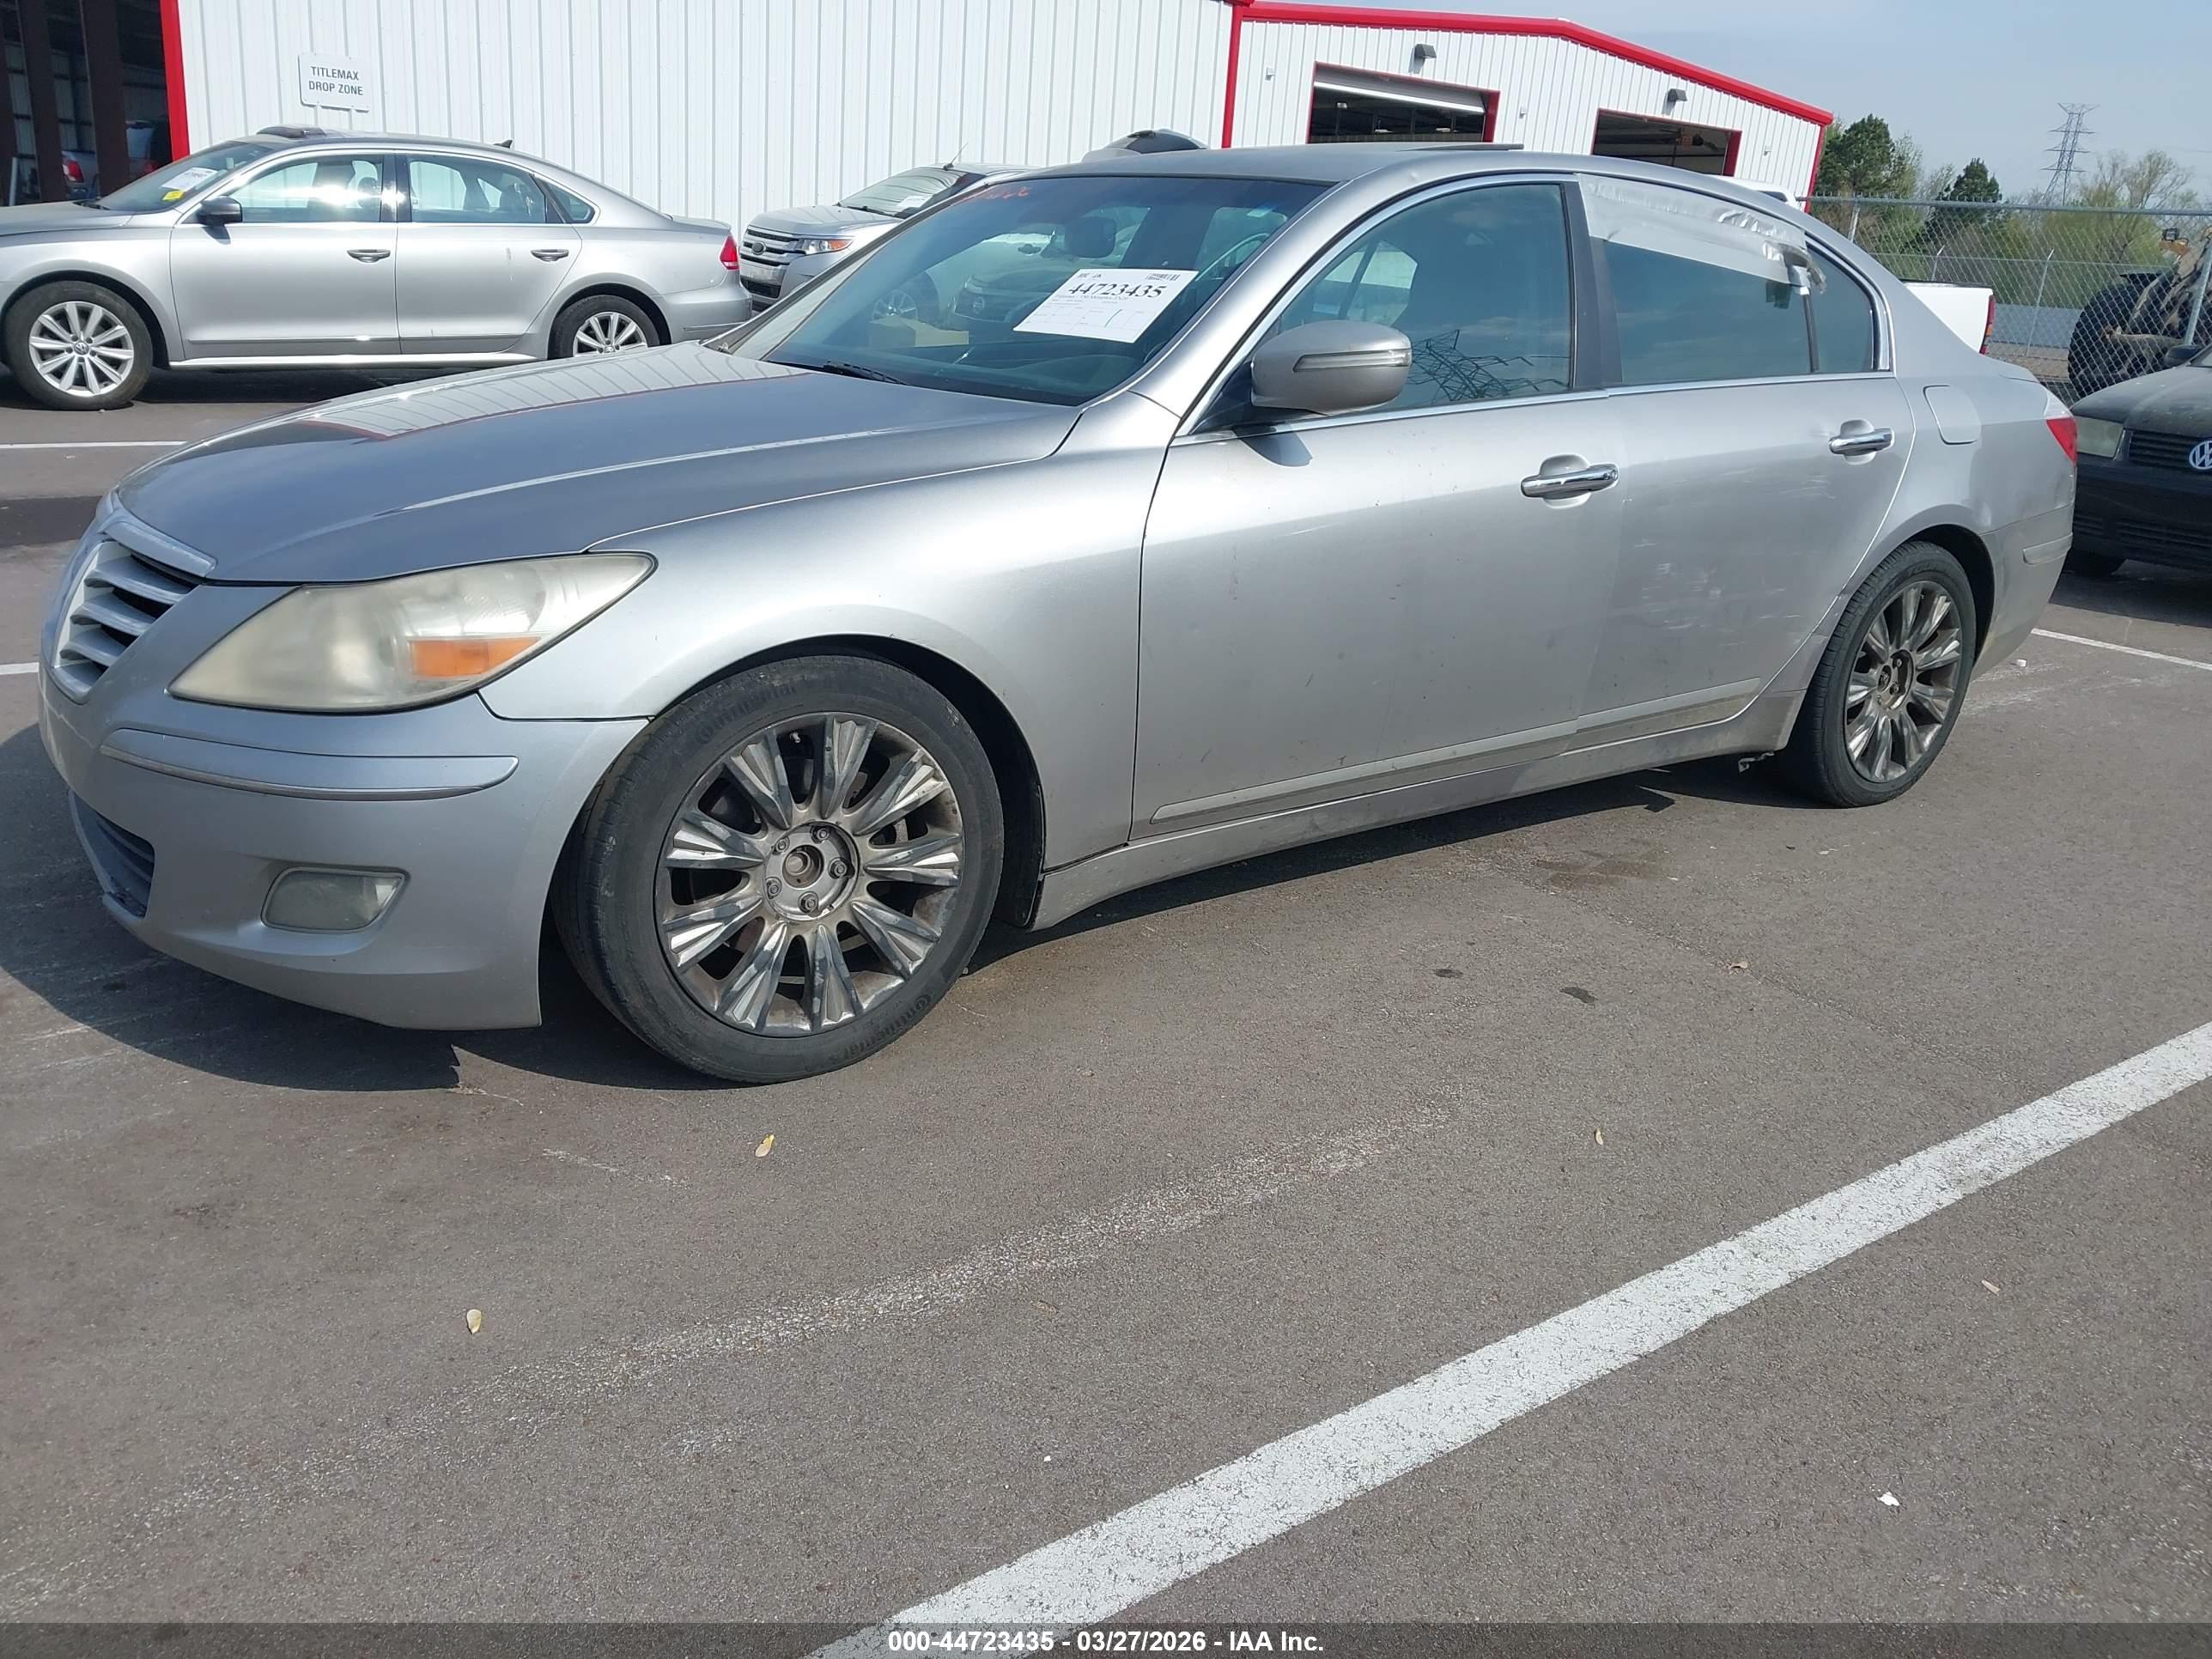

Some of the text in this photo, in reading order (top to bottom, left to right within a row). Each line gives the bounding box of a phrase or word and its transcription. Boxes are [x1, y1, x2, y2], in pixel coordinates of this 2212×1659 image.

[310, 66, 359, 81] TITLEMAX
[309, 81, 363, 95] DROP ZONE
[1069, 283, 1167, 298] 44723435
